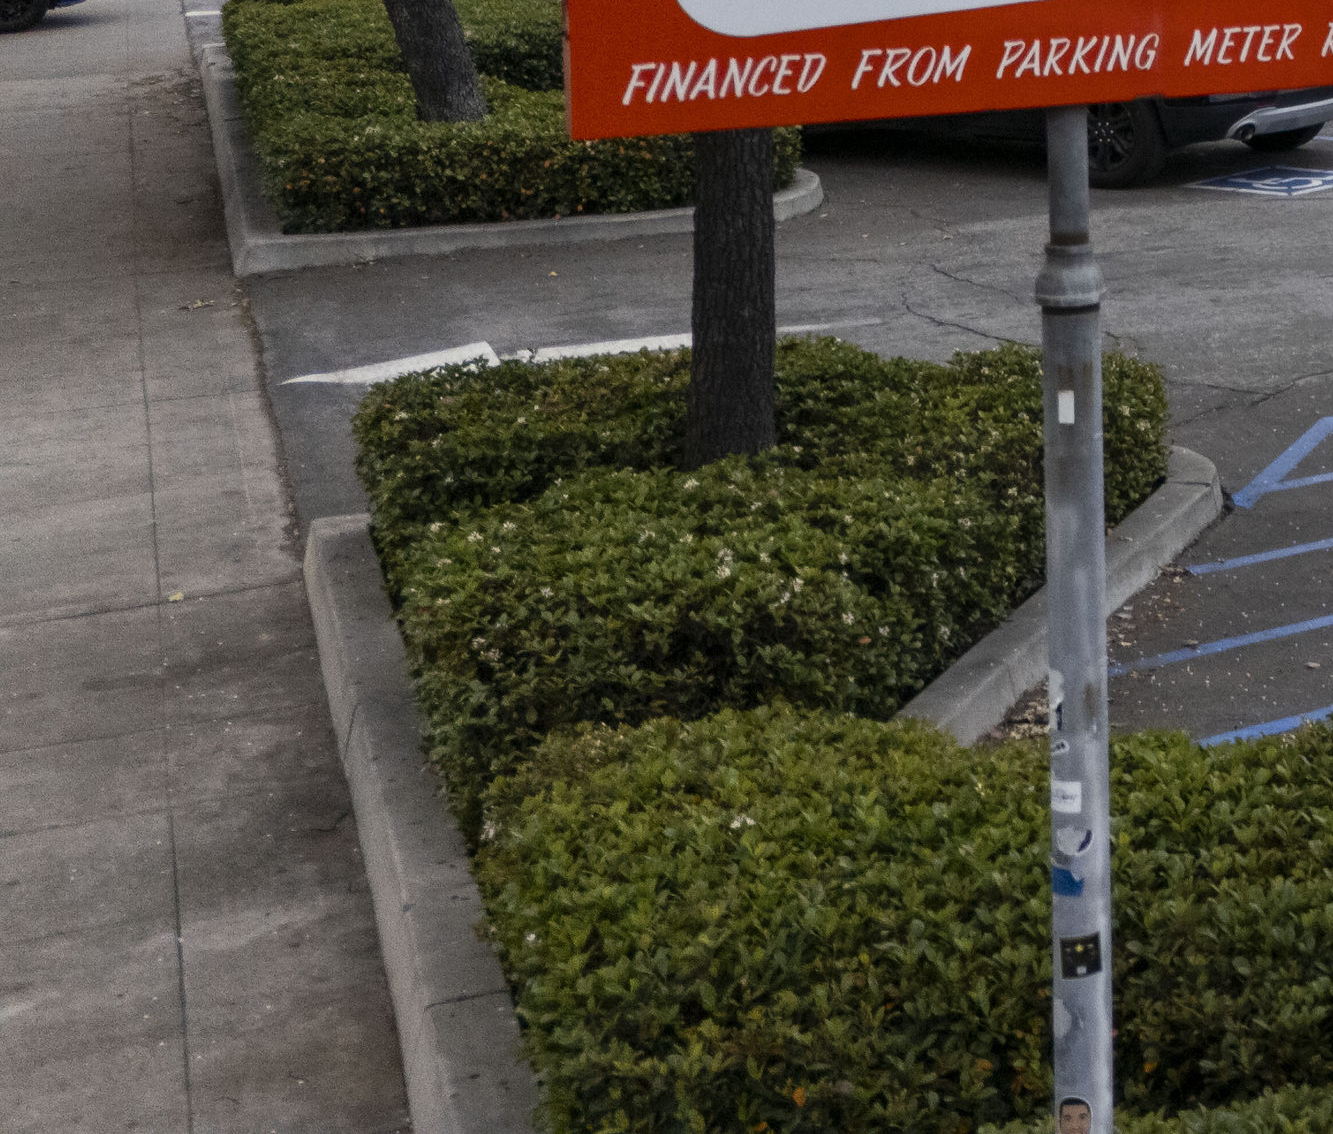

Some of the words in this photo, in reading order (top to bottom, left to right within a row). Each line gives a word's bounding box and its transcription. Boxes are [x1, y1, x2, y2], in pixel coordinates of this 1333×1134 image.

[621, 53, 828, 107] FINANCED
[850, 44, 972, 90] FROM
[996, 32, 1160, 80] PARKING
[1183, 23, 1303, 68] METER
